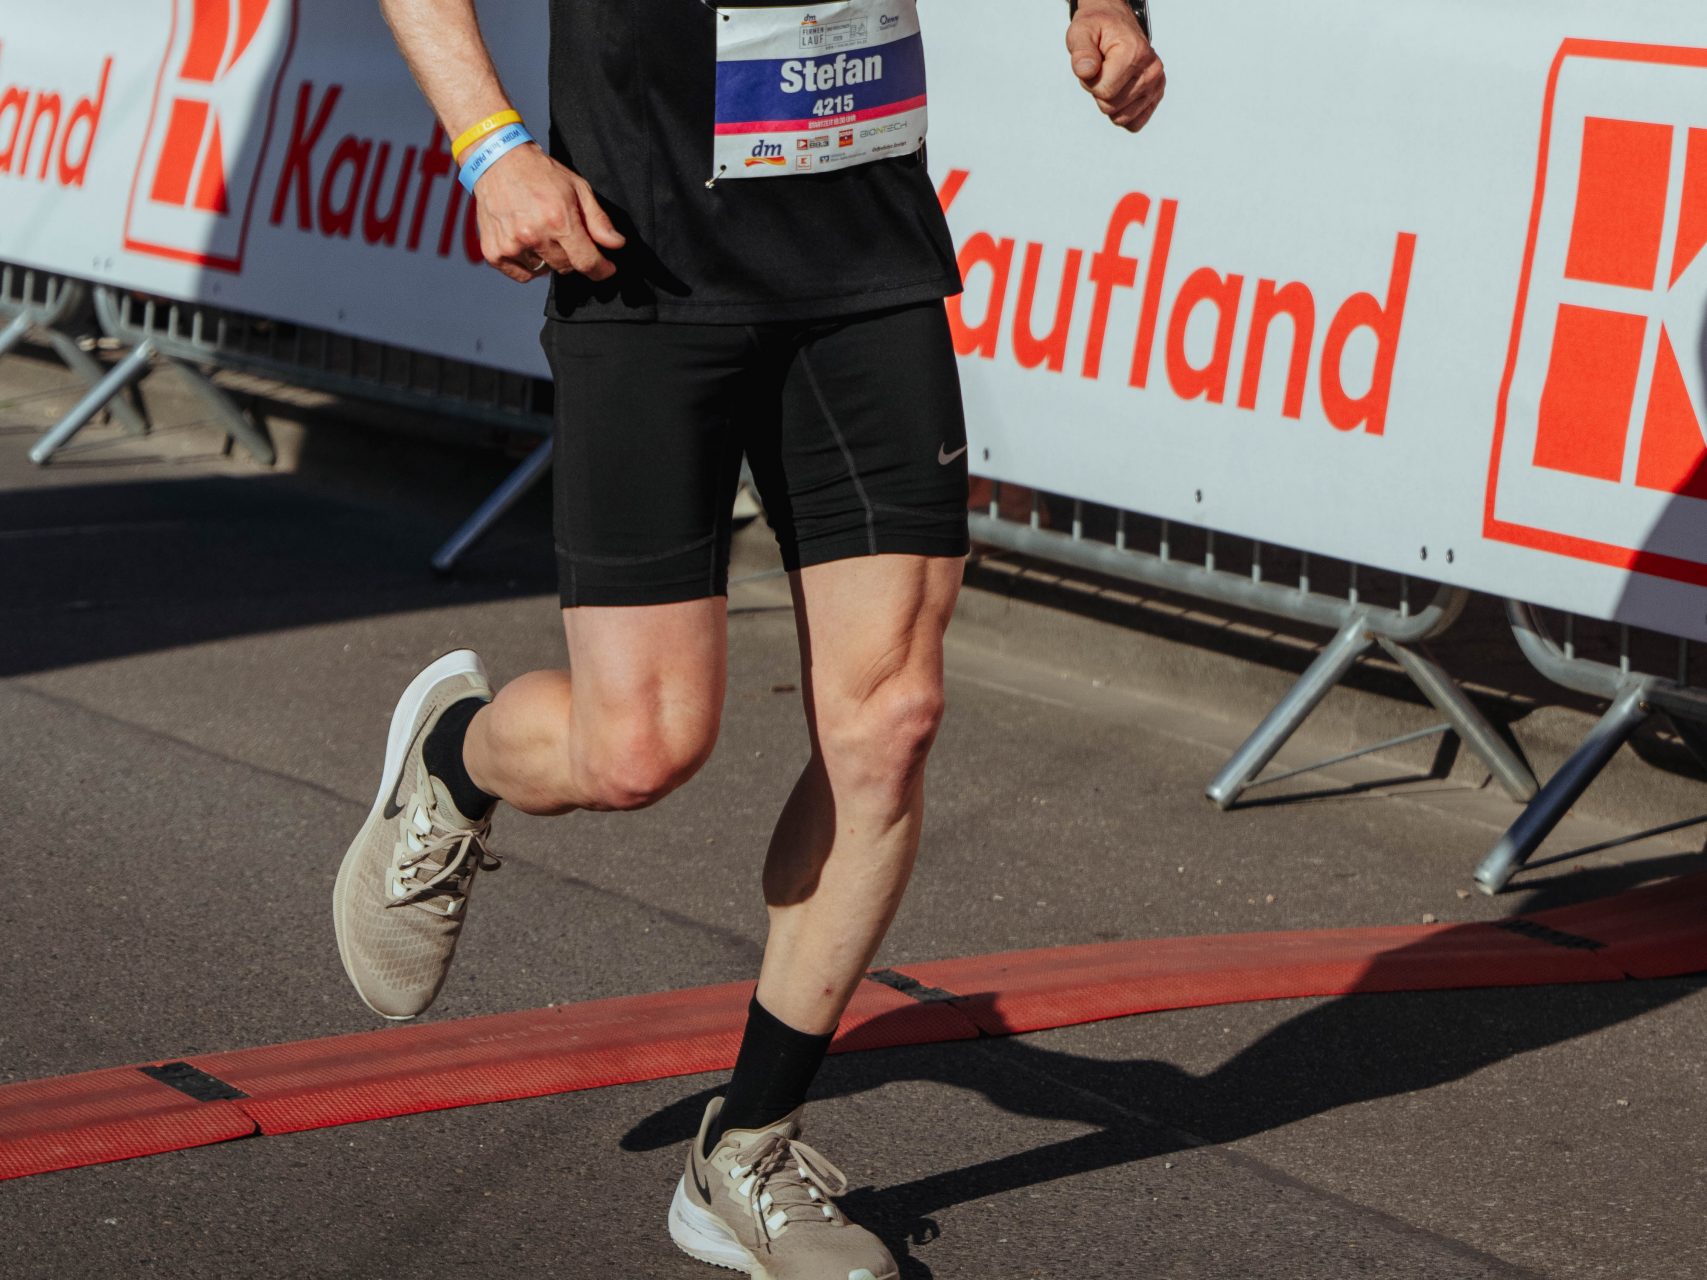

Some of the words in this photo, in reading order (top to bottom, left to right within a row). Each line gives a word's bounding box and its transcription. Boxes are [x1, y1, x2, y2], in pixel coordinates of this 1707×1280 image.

[802, 34, 824, 46] LAUF
[780, 53, 882, 94] Stefan
[0, 40, 114, 190] and
[813, 94, 854, 117] 4215
[752, 139, 782, 157] dm
[937, 167, 1418, 437] aufland
